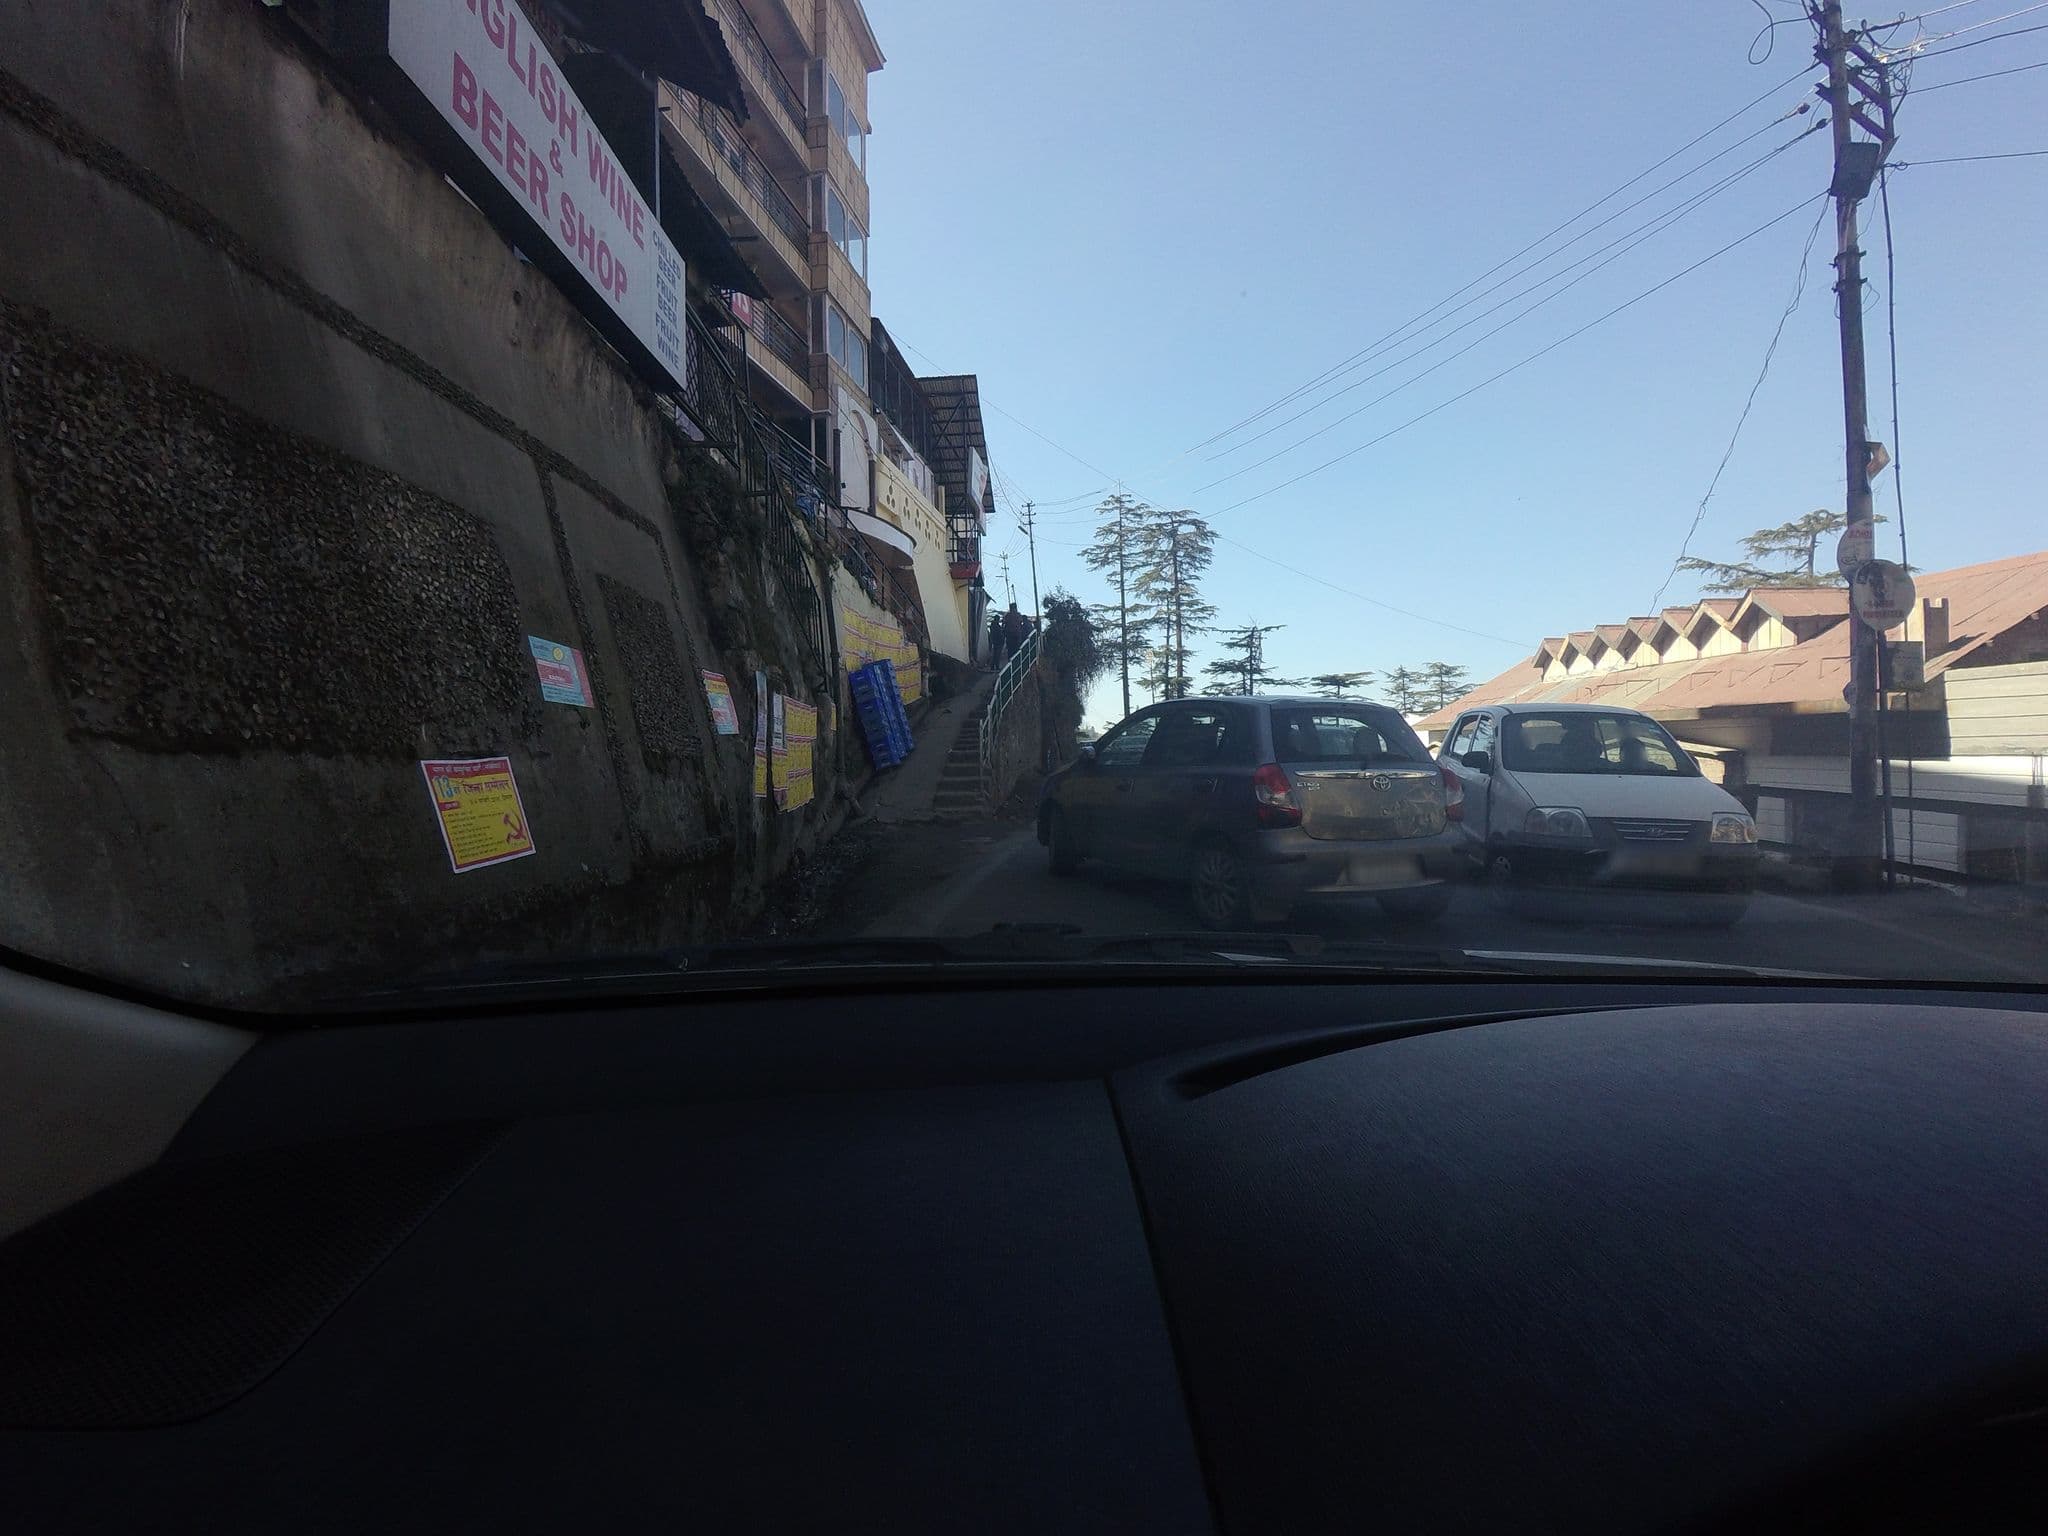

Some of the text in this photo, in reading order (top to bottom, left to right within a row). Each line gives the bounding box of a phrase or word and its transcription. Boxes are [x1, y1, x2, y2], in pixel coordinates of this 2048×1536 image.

[466, 0, 645, 250] GLISH WINE
[452, 51, 628, 304] BEER SHOP
[550, 140, 564, 178] &
[653, 230, 681, 280] CHILLED
[658, 254, 676, 290] BEER
[656, 273, 678, 313] FRUIT
[657, 293, 677, 330] BEER
[655, 311, 679, 351] FRUIT
[657, 334, 679, 371] WINE
